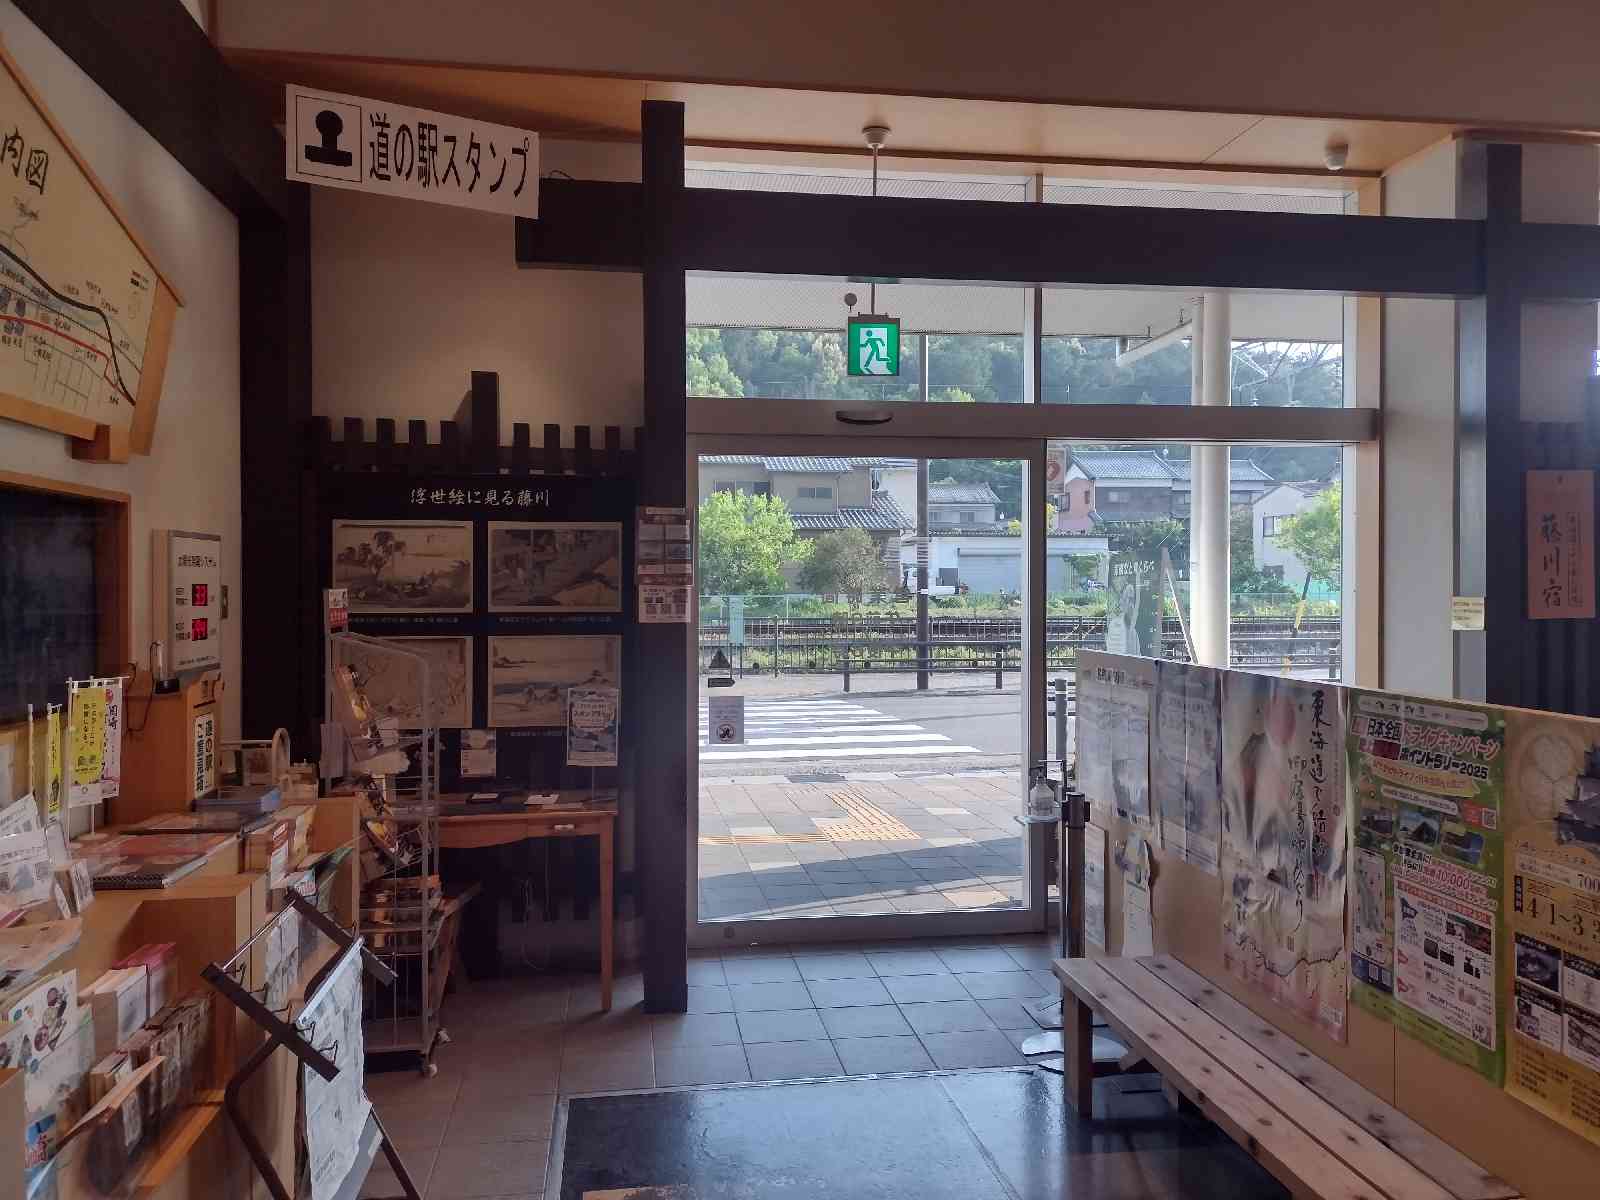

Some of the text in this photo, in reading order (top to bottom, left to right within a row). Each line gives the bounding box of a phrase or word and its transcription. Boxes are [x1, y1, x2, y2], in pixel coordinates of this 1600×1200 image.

[369, 112, 529, 197] 道の駅スタンプ
